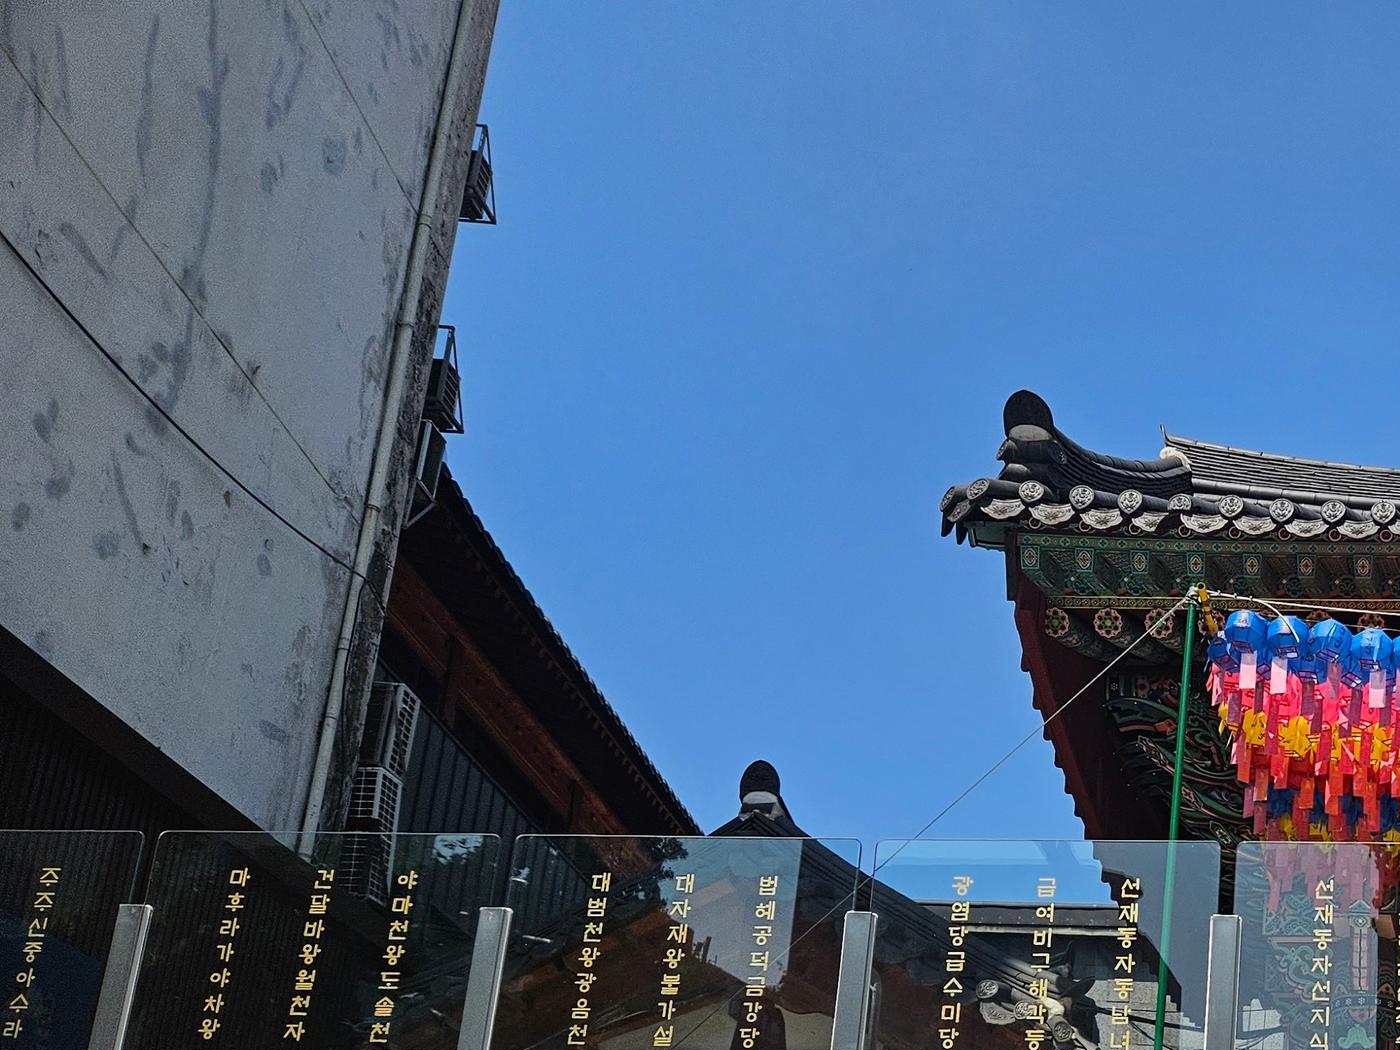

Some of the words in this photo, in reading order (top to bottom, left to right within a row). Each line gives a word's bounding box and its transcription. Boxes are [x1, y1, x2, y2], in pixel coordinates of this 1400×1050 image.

[3, 867, 61, 1038] 주주신중아수라
[199, 868, 250, 1040] 마후라가야차왕
[283, 869, 334, 1041] 건달바왕월천자
[369, 871, 418, 1043] 야마천왕도솔천
[568, 873, 611, 1046] 대범천왕광음천
[653, 874, 695, 1047] 대자재왕불가설
[739, 875, 778, 1049] 법혜공덕금강당
[938, 875, 974, 1049] 광염당급수미당
[1024, 877, 1057, 1050] 급여비구해각등
[1110, 877, 1141, 1050] 선재동자동남녀
